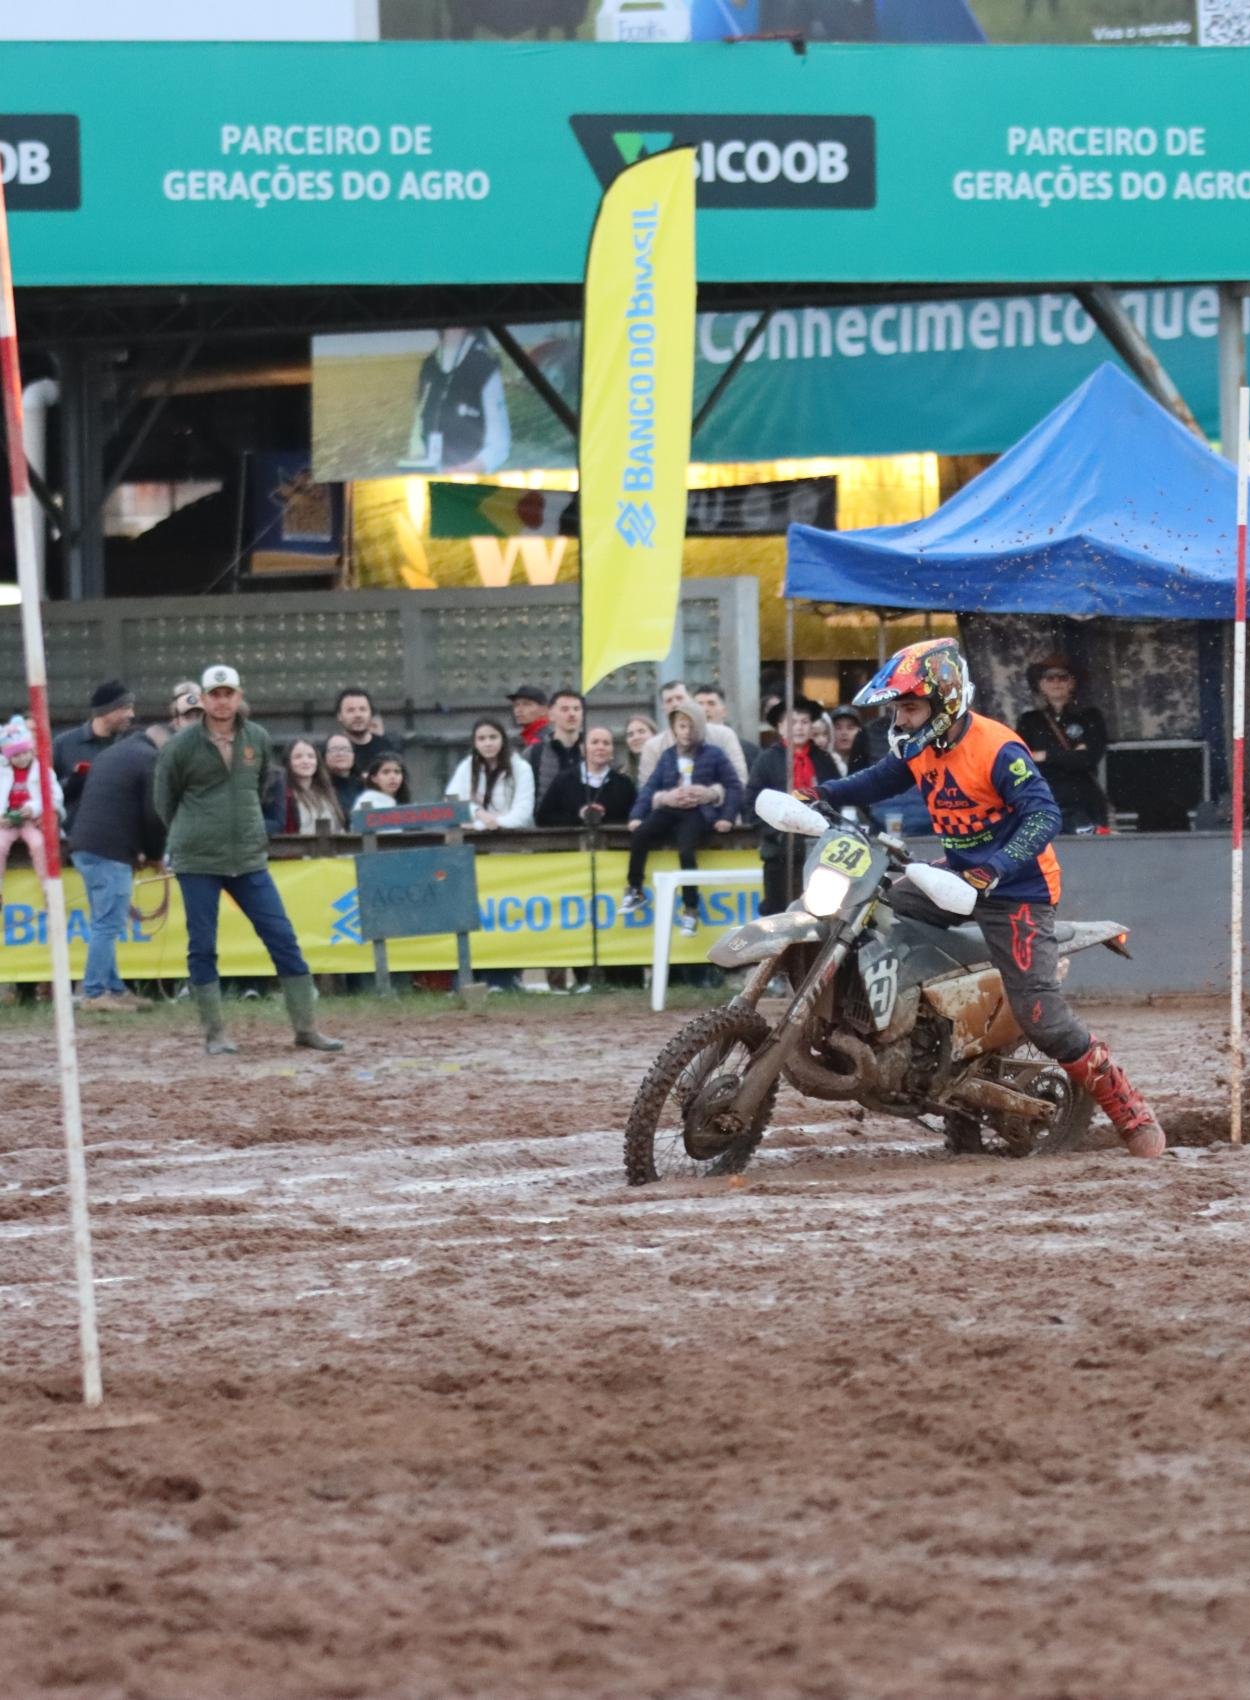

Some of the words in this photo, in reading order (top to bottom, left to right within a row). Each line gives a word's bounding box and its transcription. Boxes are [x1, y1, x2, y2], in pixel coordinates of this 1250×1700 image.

[221, 125, 381, 155] PARCEIRO
[390, 125, 432, 155] DE
[1007, 127, 1157, 156] PARCEIRO
[1165, 127, 1206, 156] DE
[694, 140, 849, 184] ICOOB
[162, 163, 333, 207] GERAÇÕES
[342, 171, 391, 200] DO
[397, 171, 491, 200] AGRO
[953, 164, 1112, 206] GERAÇÕES
[1120, 171, 1166, 200] DO
[627, 322, 656, 370] DO
[622, 374, 656, 493] BANCO
[828, 840, 868, 872] 34
[477, 895, 554, 933] NCO
[560, 894, 617, 931] DO
